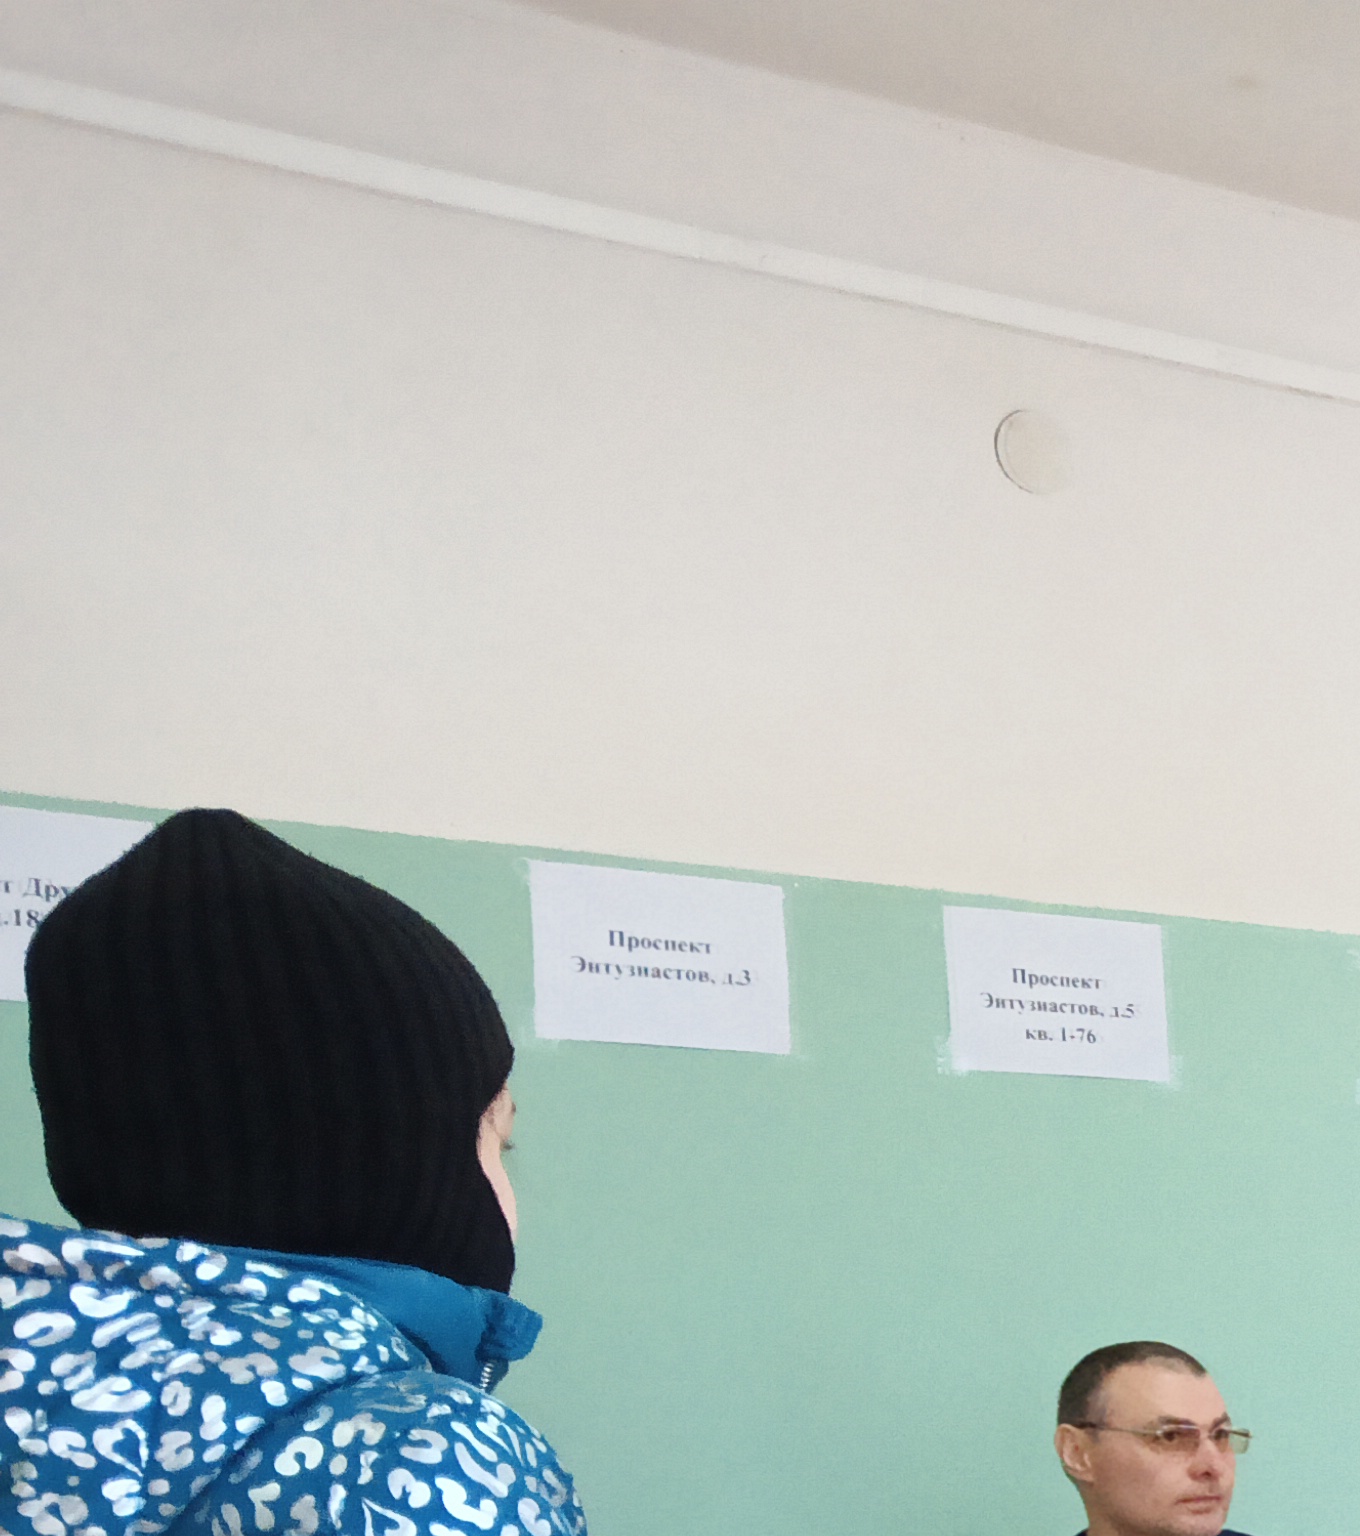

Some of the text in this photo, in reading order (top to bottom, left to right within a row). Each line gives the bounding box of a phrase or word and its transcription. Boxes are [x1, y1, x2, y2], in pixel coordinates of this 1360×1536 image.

[607, 929, 712, 954] Проспект
[570, 955, 751, 986] Энтузиастов, д.3
[1011, 967, 1102, 989] Проспект
[980, 992, 1105, 1017] Энтузиастов,
[1025, 1026, 1097, 1044] кв. 1-76
